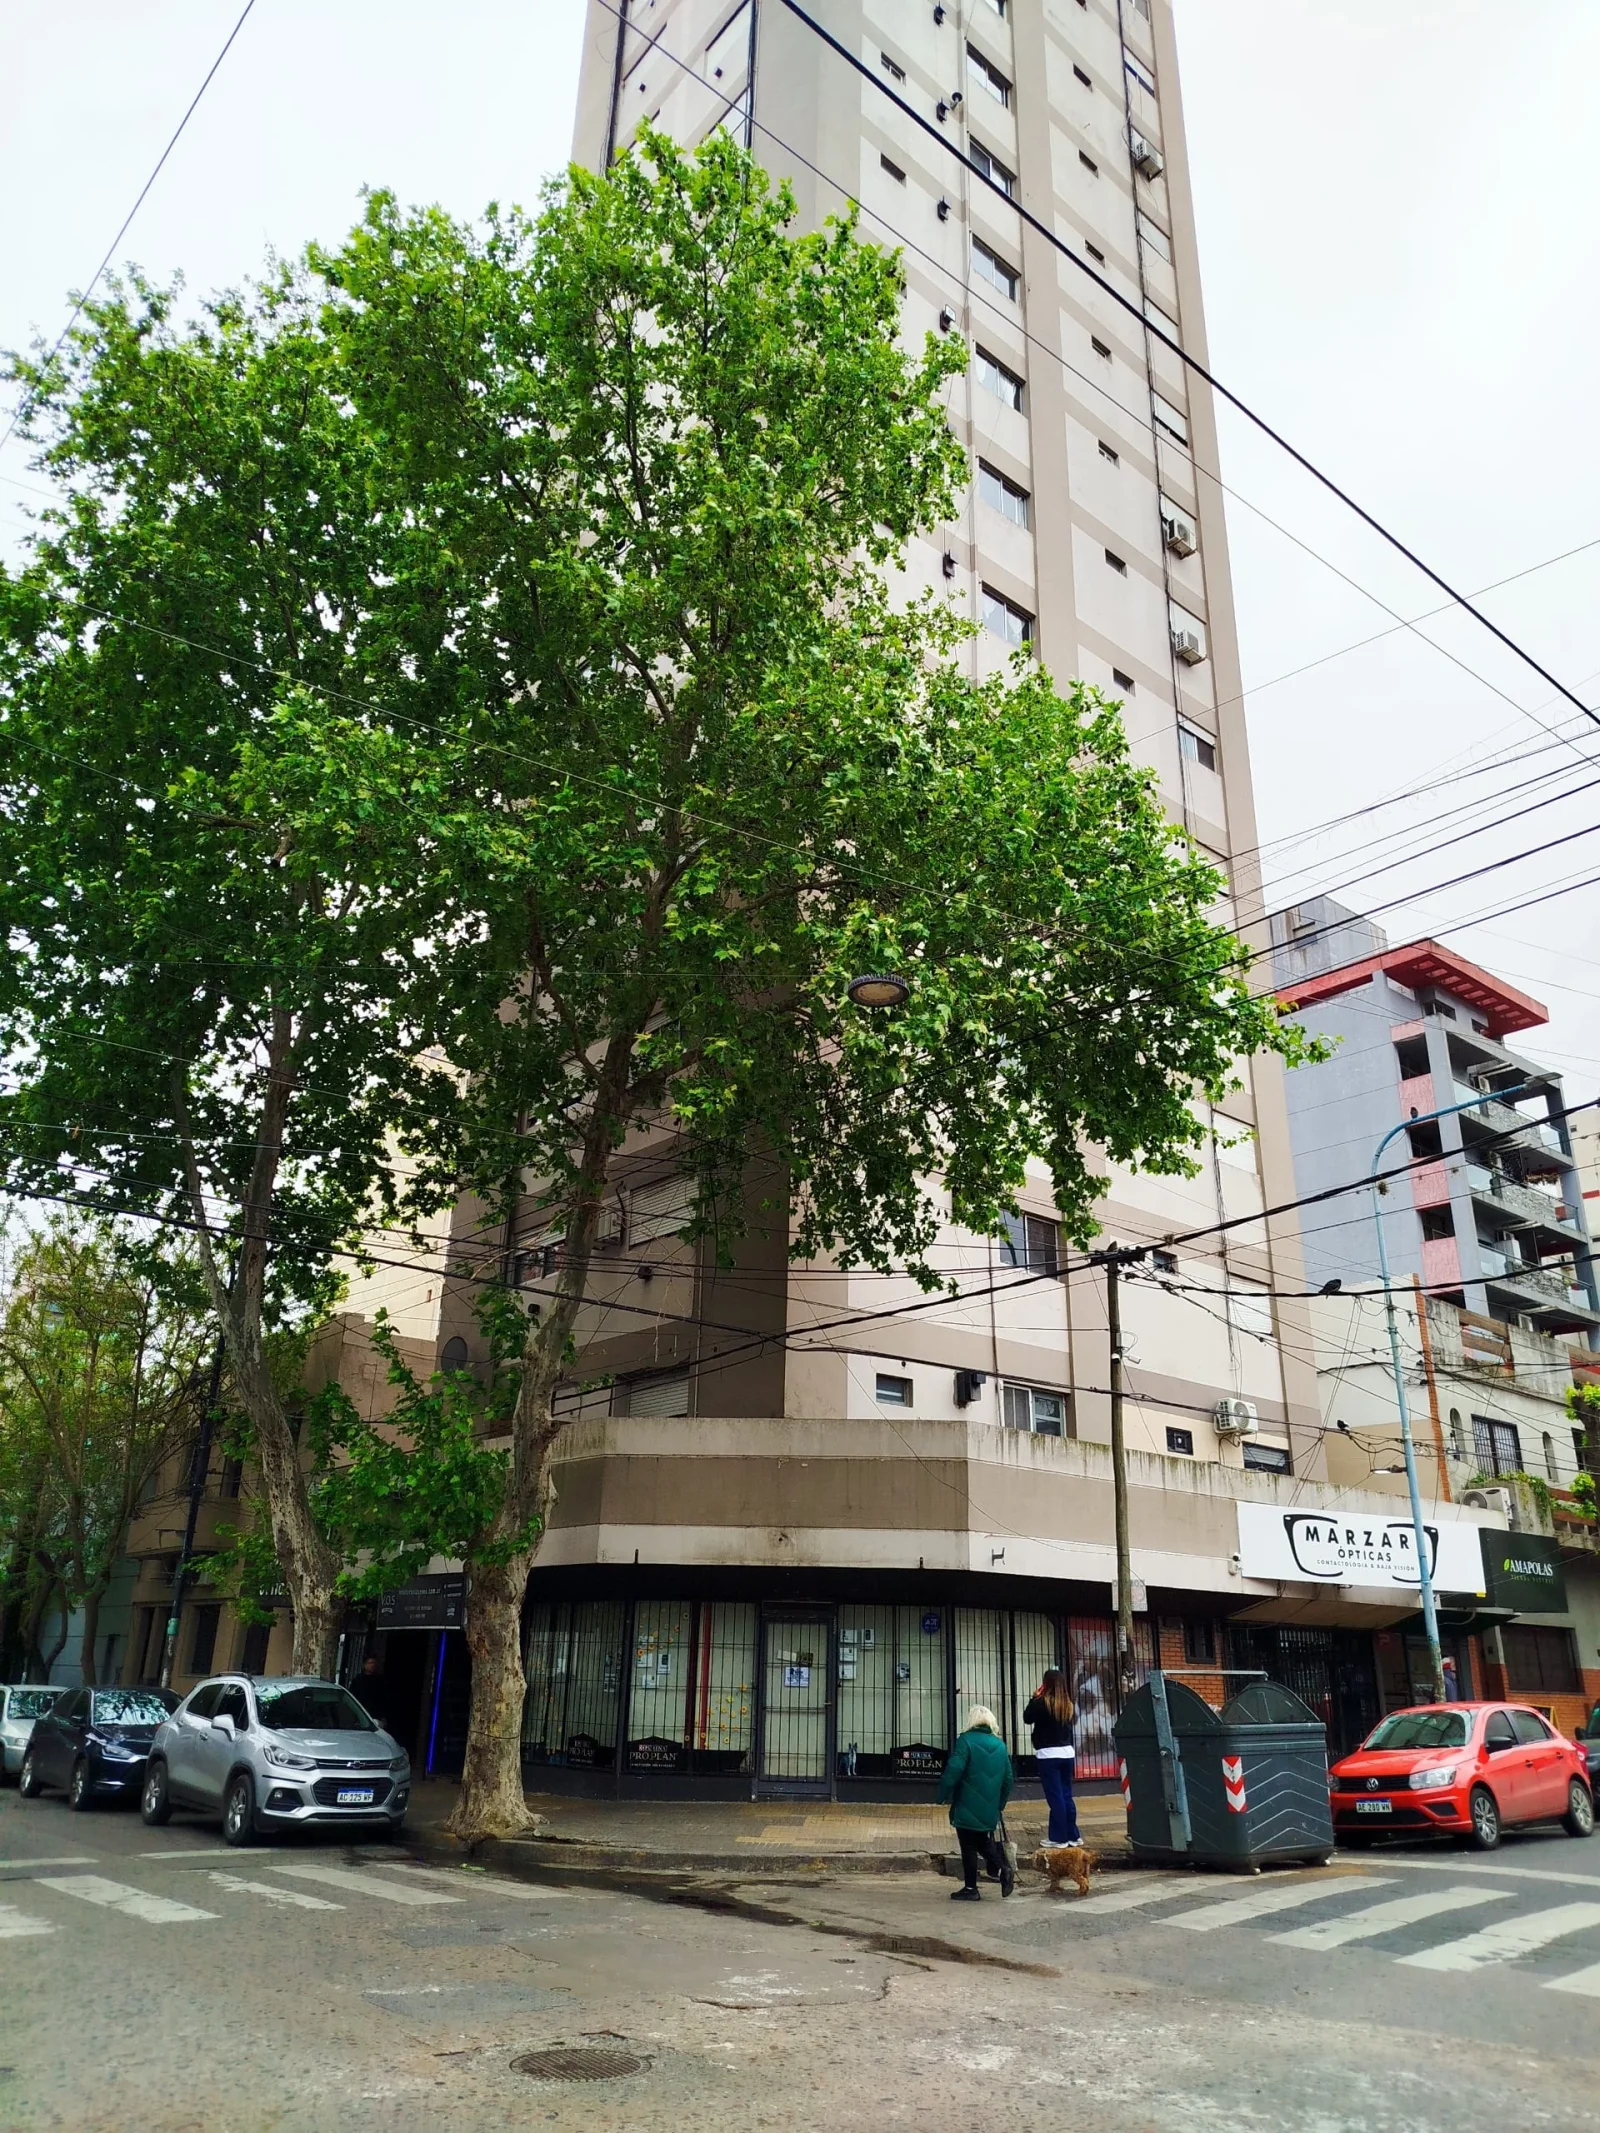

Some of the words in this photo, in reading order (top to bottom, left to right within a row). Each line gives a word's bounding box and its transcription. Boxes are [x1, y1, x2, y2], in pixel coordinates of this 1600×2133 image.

[1305, 1525, 1410, 1549] MARZAR
[1338, 1546, 1392, 1562] ÓPTICAS
[1510, 1559, 1553, 1577] AMAPOLAS
[915, 1759, 943, 1768] PLAN
